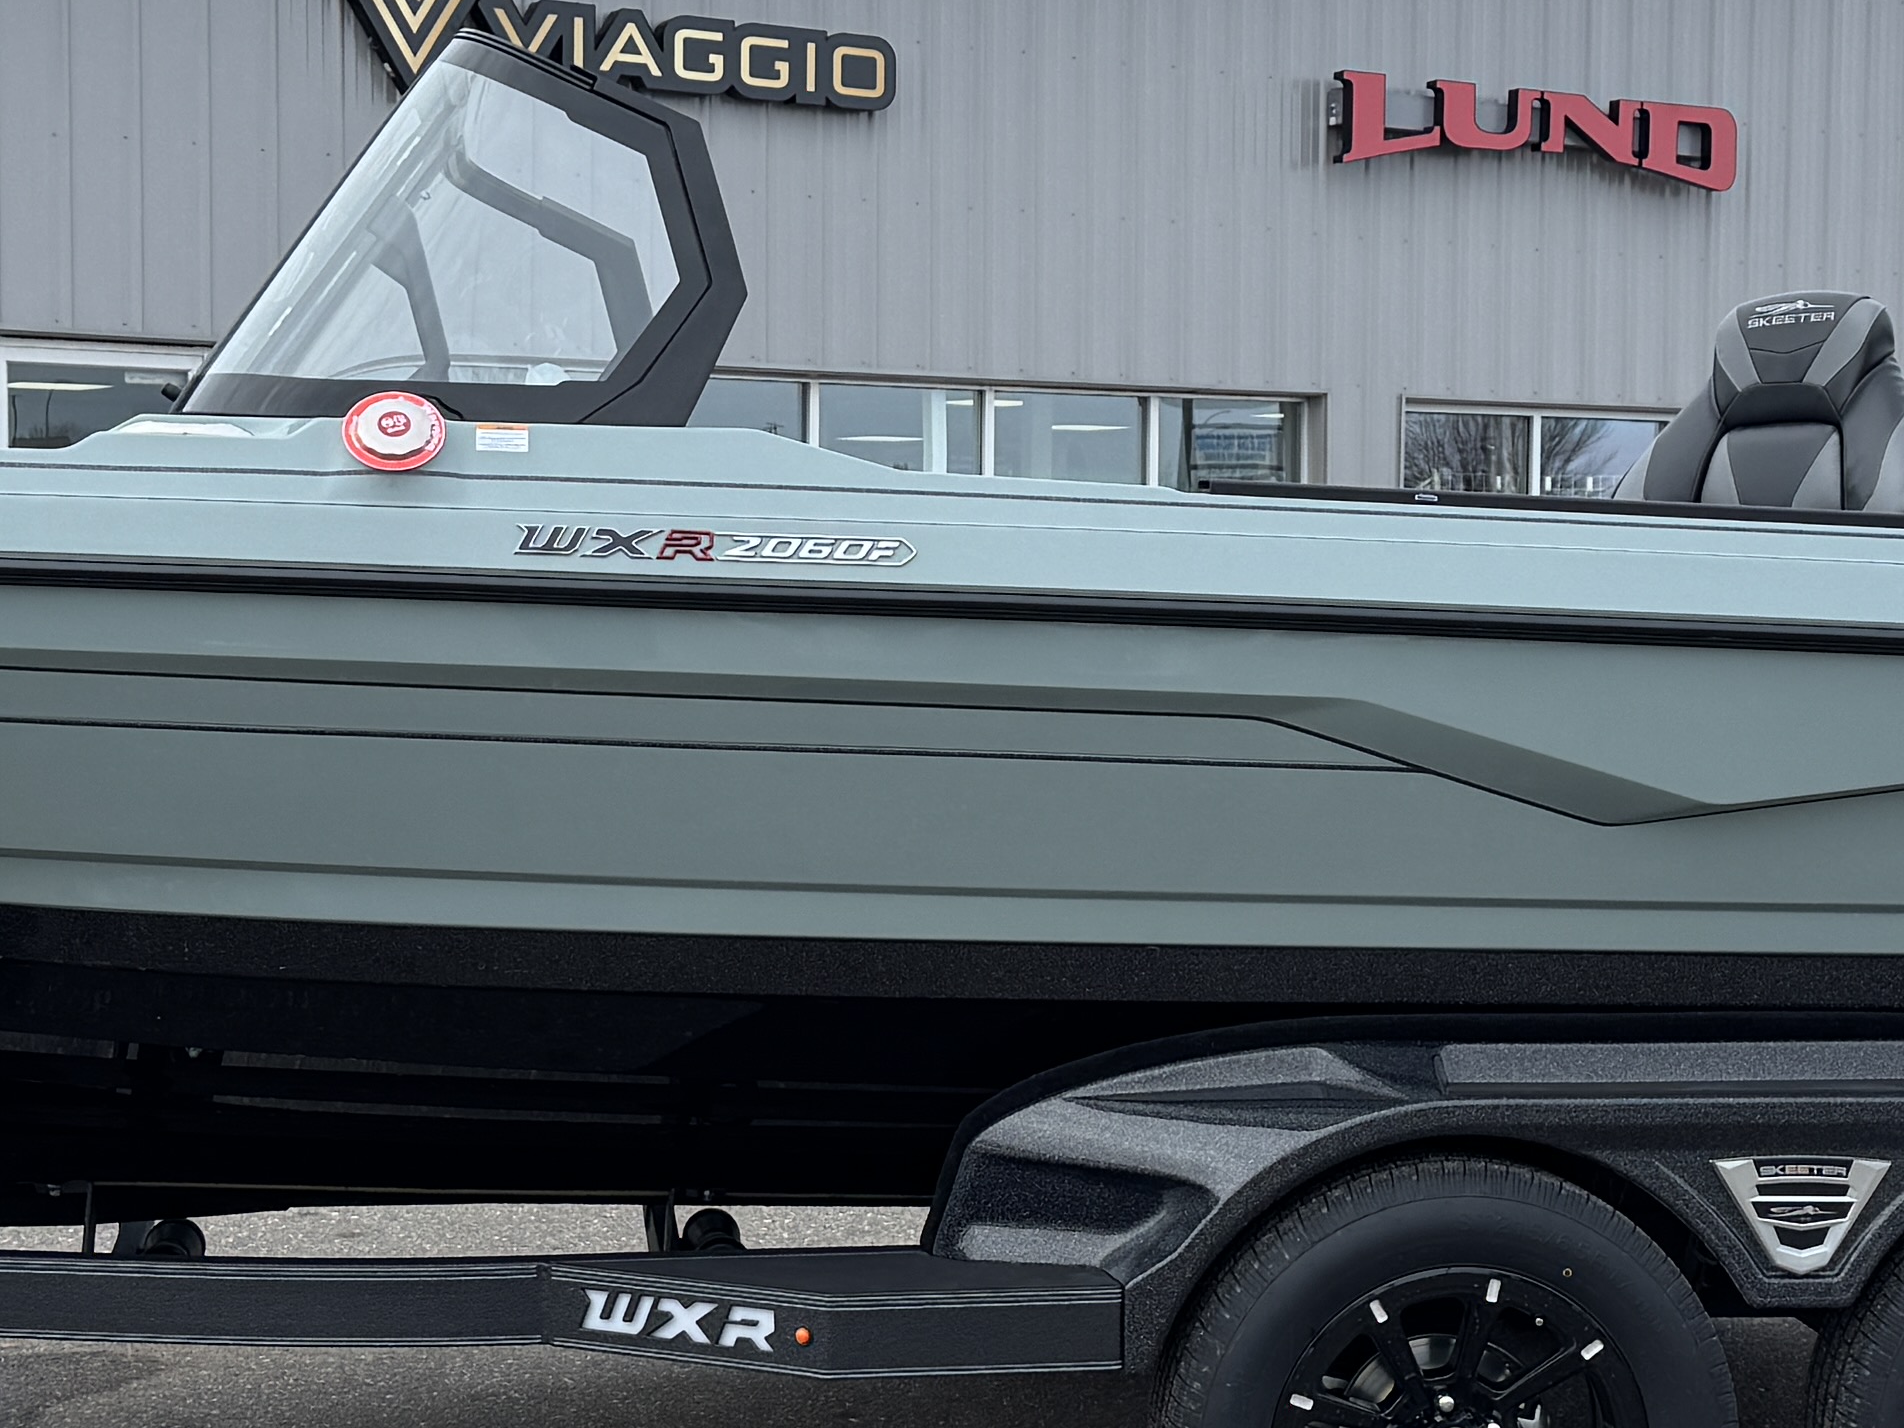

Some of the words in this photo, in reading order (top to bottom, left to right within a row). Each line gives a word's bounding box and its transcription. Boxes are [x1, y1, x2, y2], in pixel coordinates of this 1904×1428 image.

[492, 7, 886, 99] VIAGGIO
[1334, 70, 1738, 192] LUND
[1747, 312, 1835, 329] SKEETER
[513, 523, 715, 562] WXR
[722, 536, 900, 562] 2060F
[1759, 1164, 1847, 1177] SKEETER
[581, 1288, 776, 1353] WXR
